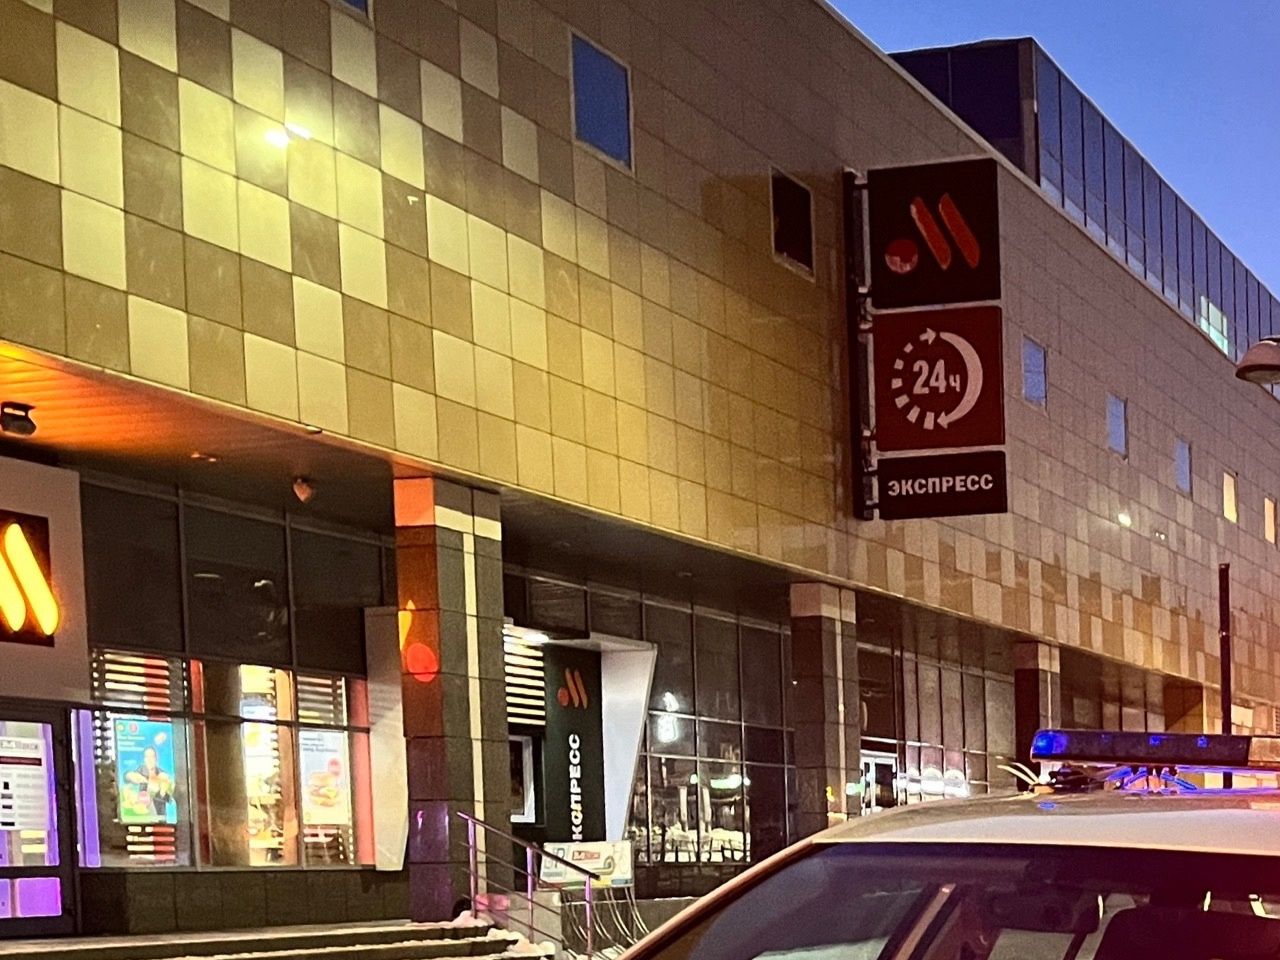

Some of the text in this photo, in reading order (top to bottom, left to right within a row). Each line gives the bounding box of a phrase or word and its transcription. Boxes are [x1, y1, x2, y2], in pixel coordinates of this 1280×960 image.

[913, 358, 960, 394] 24ч
[887, 474, 993, 496] ЭКСПРЕСС
[568, 733, 584, 842] КСПРЕСС
